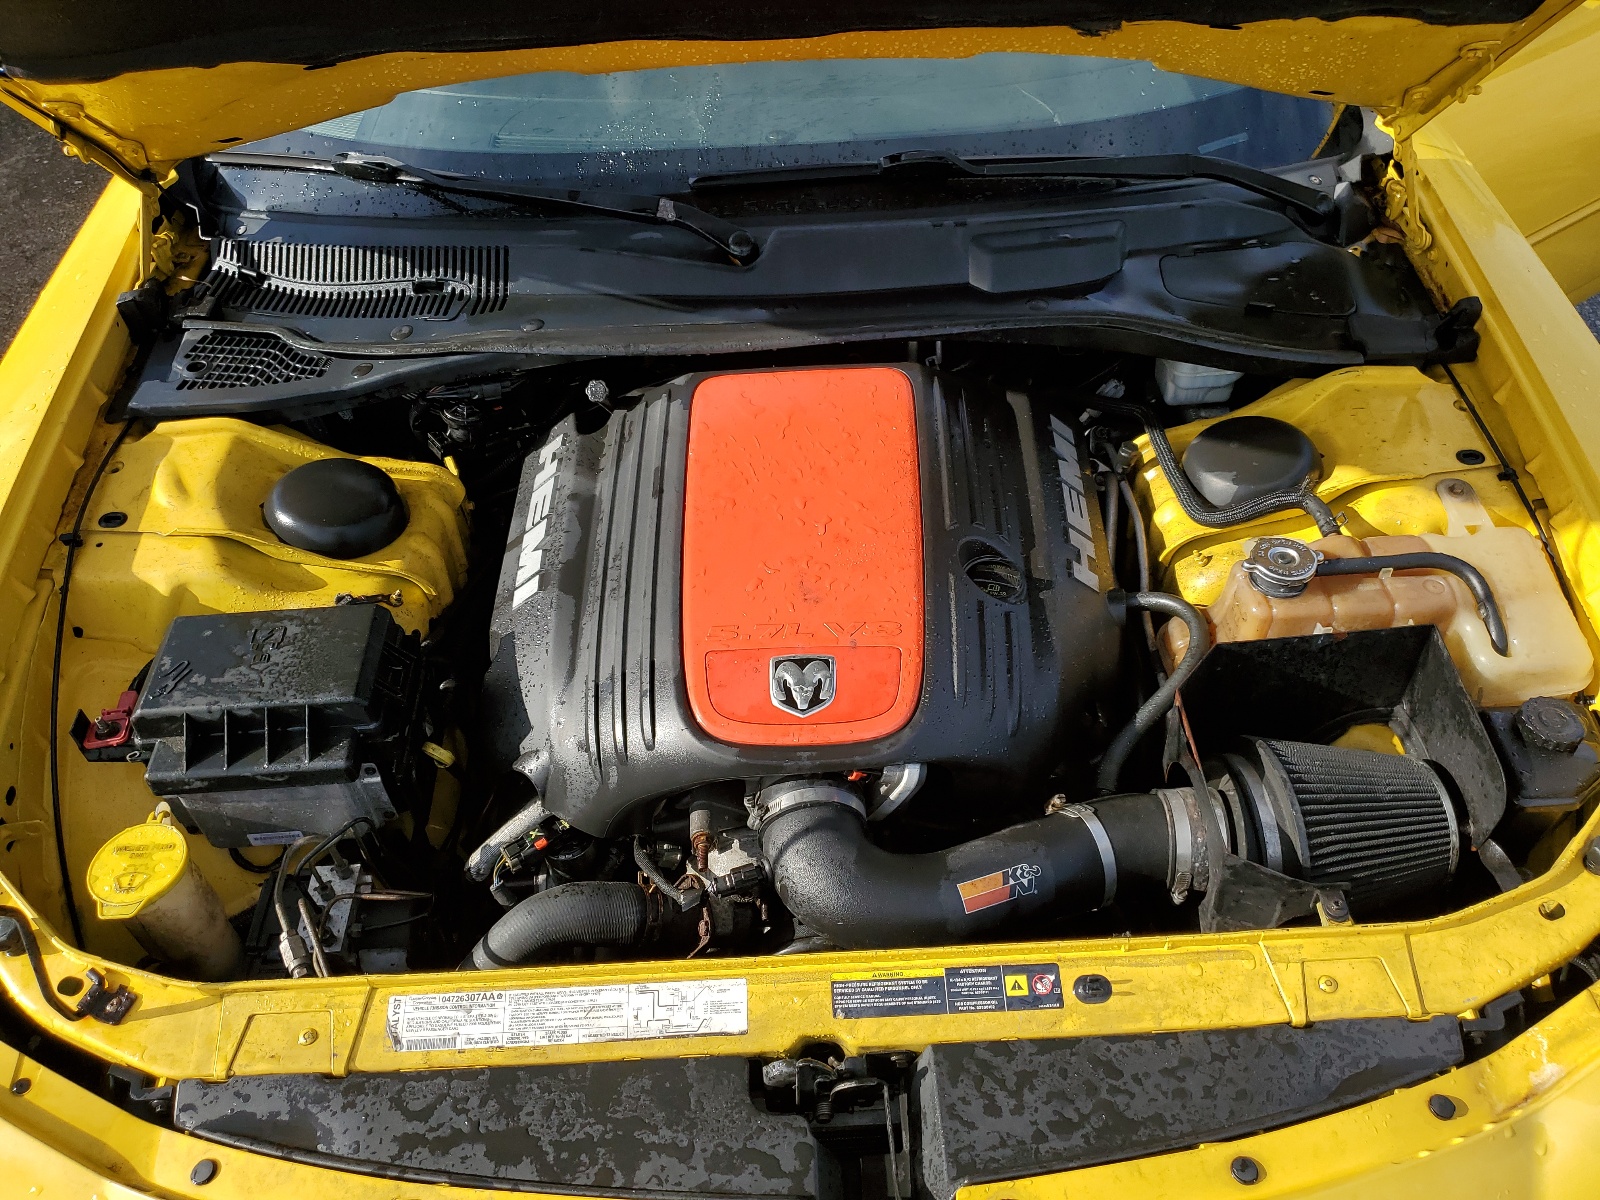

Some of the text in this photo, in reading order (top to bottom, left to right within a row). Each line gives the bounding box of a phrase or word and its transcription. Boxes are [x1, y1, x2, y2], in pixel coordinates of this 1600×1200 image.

[1050, 414, 1100, 592] HEMI
[512, 433, 564, 610] HEMI
[705, 623, 814, 640] 5.7L
[1003, 864, 1041, 898] K&N
[441, 992, 496, 1003] 04726307AA
[391, 998, 402, 1035] TALYST
